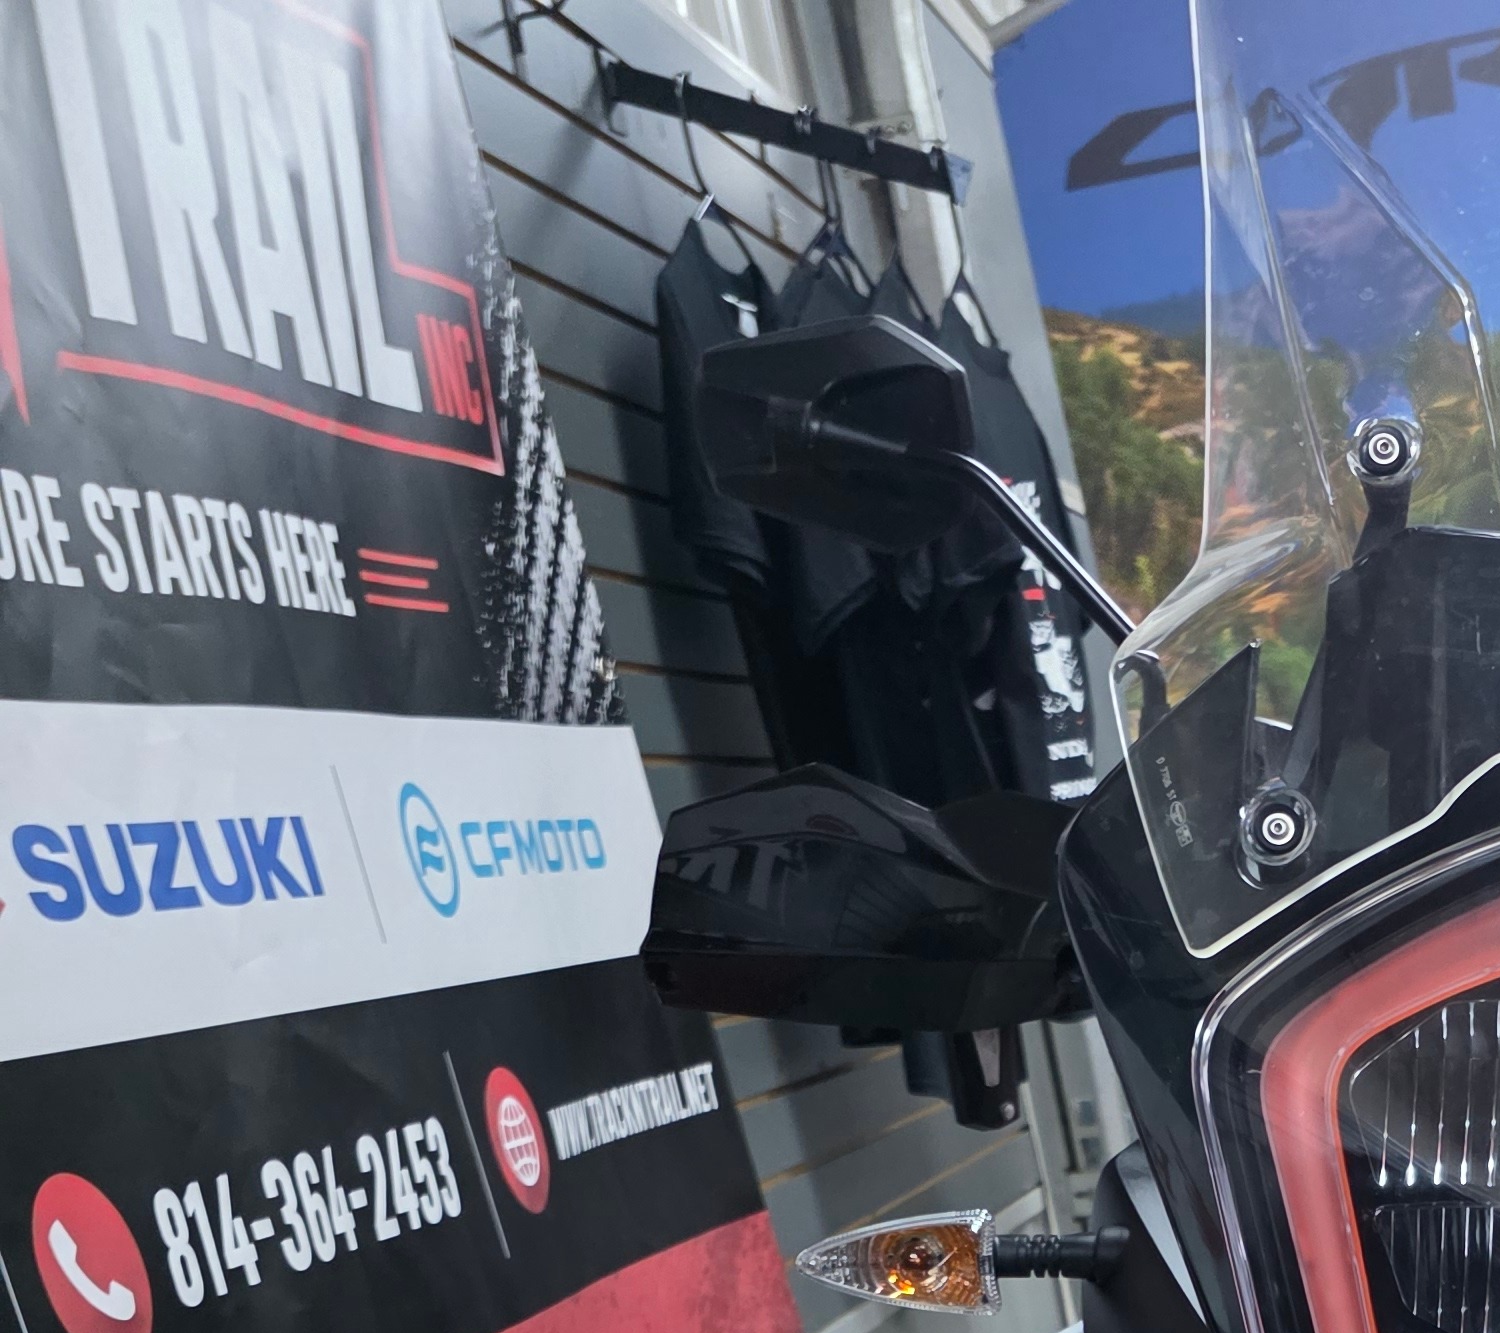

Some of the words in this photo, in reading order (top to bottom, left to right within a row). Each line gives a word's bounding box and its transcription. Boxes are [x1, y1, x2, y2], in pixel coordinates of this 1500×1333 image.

[416, 312, 485, 425] INC
[80, 481, 267, 605] STARTS
[258, 508, 357, 617] HERE
[11, 815, 325, 922] SUZUKI
[459, 817, 608, 879] CFMOTO
[153, 1116, 463, 1308] 814-364-2453
